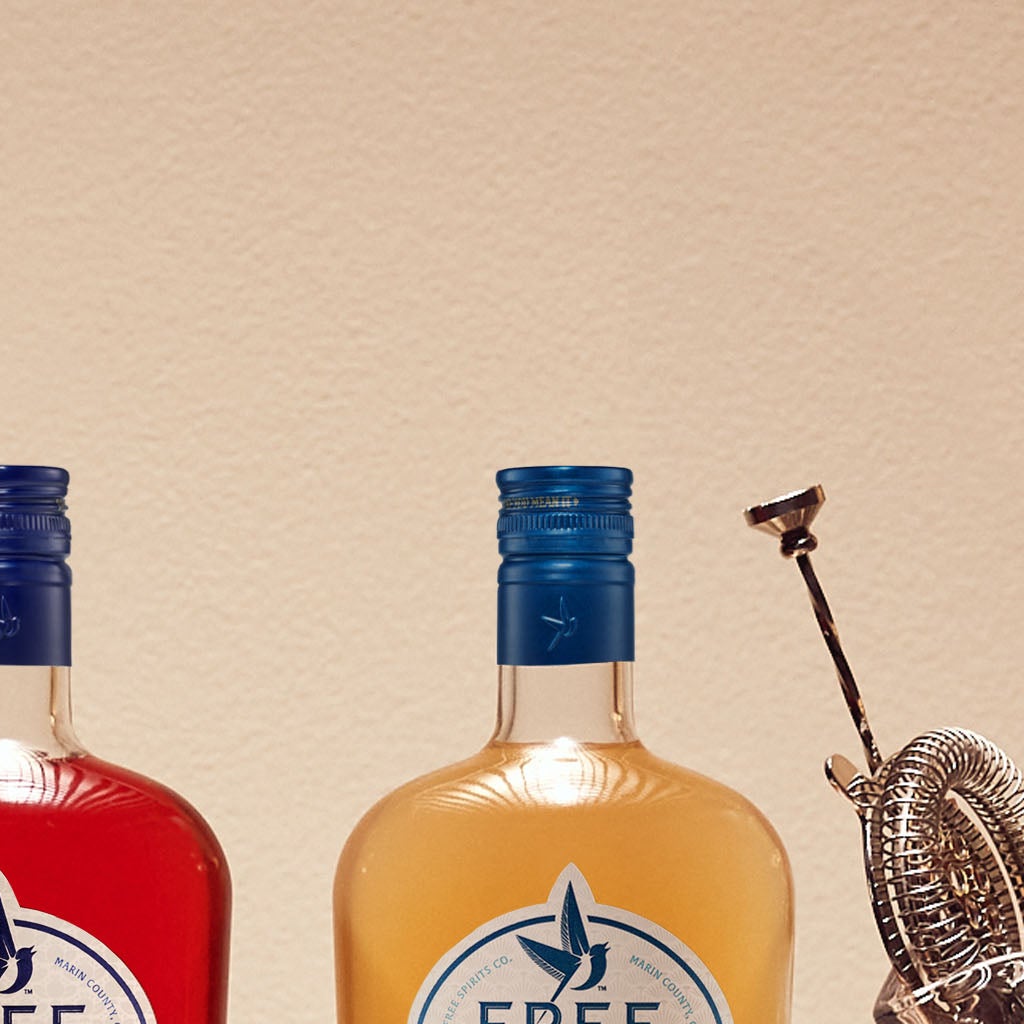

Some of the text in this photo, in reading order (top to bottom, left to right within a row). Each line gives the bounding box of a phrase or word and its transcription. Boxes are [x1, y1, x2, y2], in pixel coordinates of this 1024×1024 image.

[54, 957, 87, 981] MARIN
[457, 965, 491, 999] SPIRITS
[493, 955, 513, 969] CO.
[629, 955, 663, 980] MARIN
[662, 978, 693, 1019] COUNTY,
